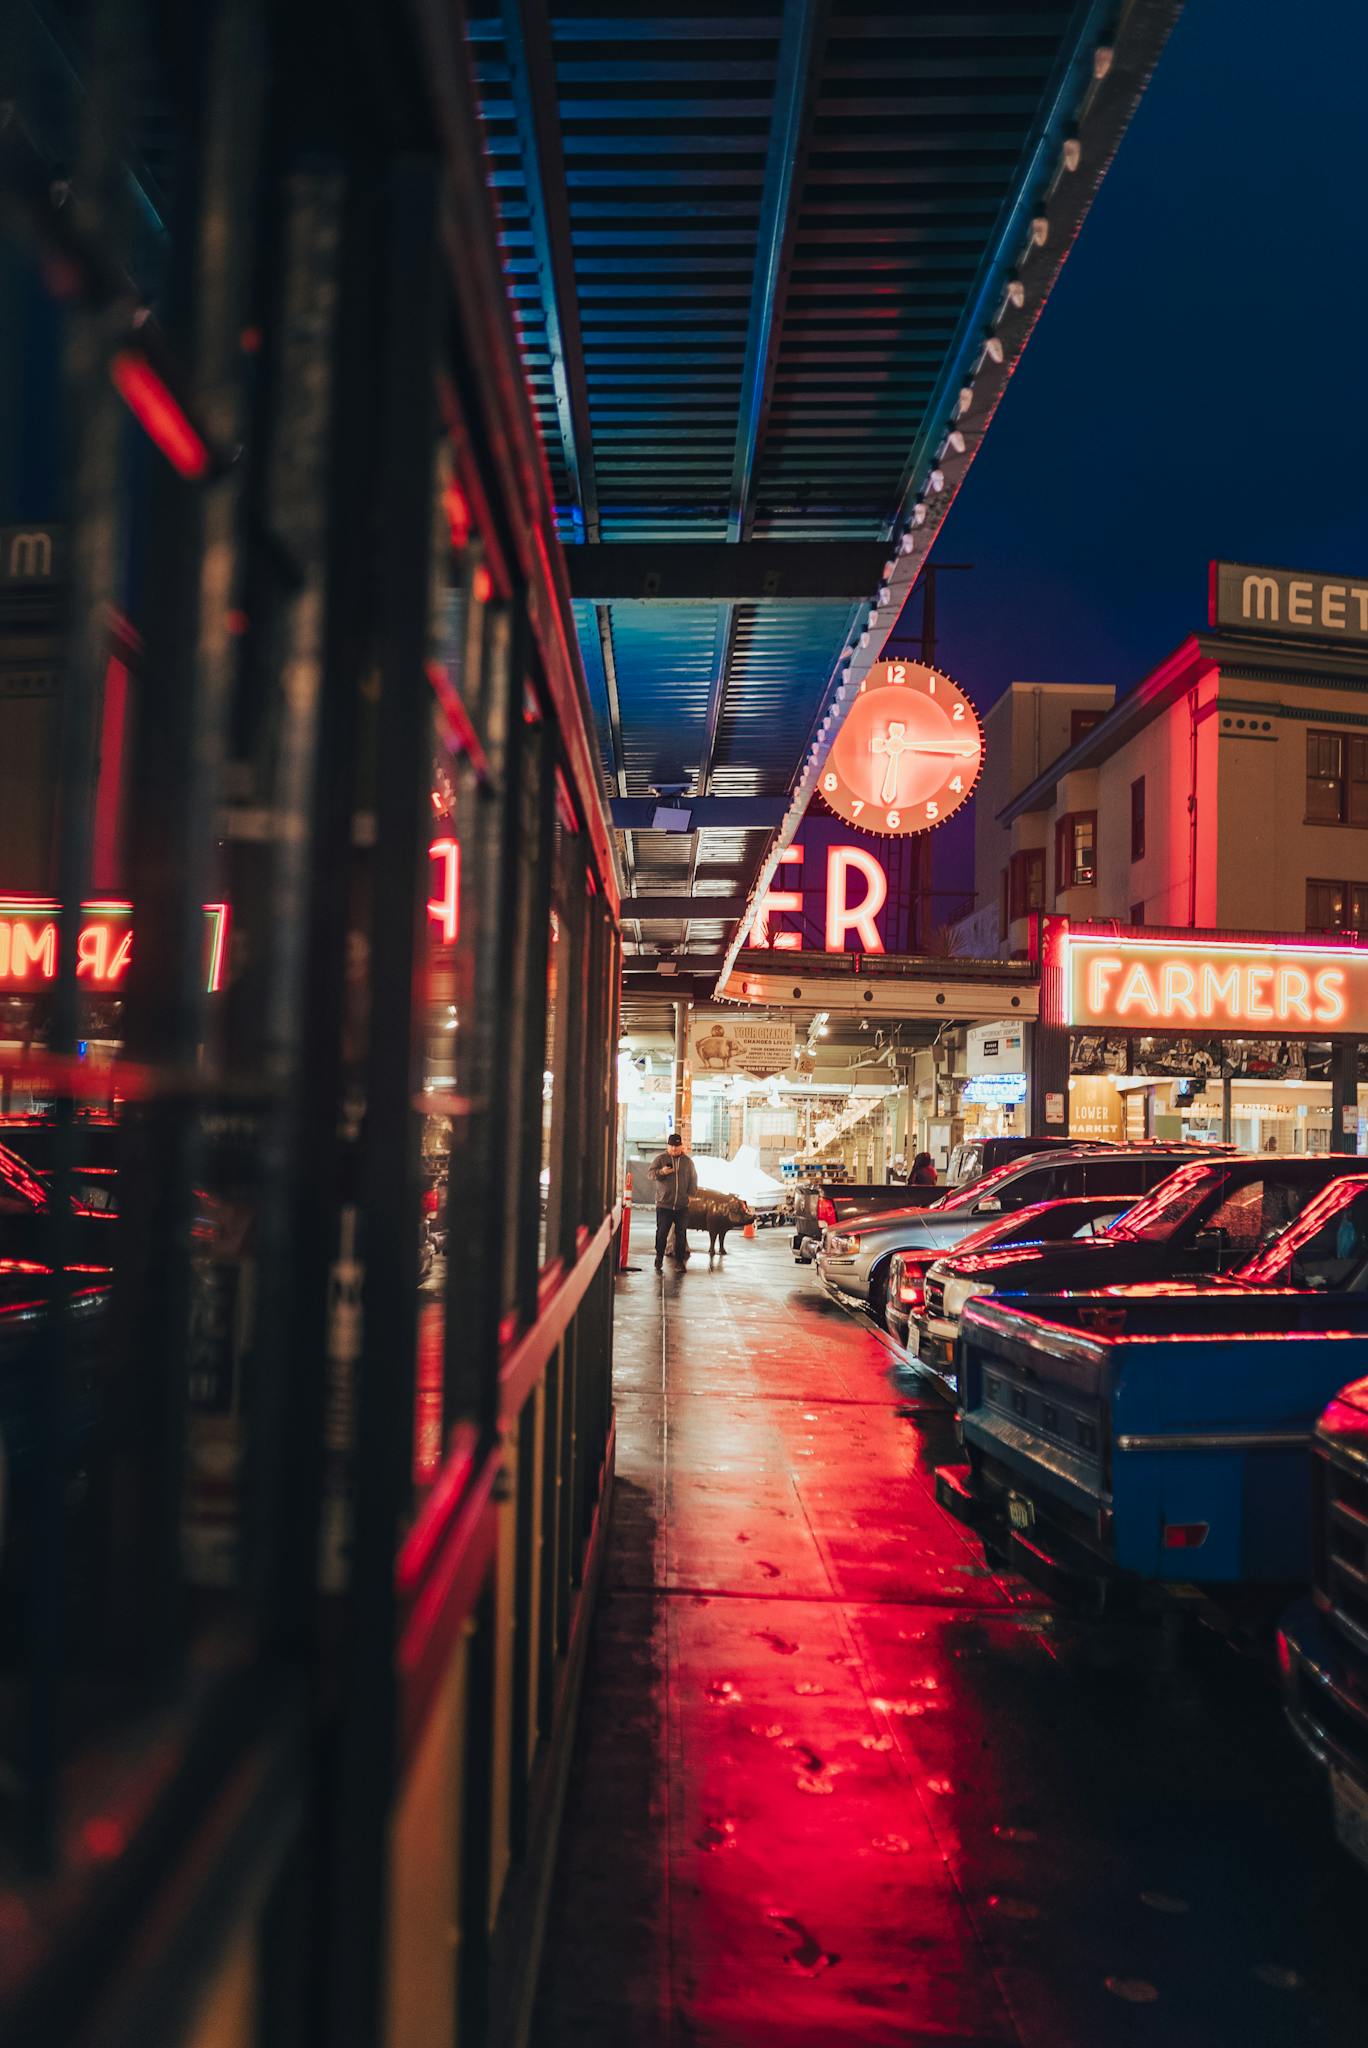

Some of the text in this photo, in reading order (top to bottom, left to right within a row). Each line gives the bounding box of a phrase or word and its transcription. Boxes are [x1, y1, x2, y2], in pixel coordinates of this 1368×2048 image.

[1242, 575, 1368, 631] MEET
[887, 665, 907, 684] 12
[929, 676, 937, 694] 1
[953, 703, 965, 721] 2
[823, 773, 838, 792] 8
[949, 775, 964, 793] 4
[851, 800, 865, 817] 7
[926, 801, 939, 819] 5
[886, 810, 901, 829] 6
[1090, 958, 1346, 1020] FARMERS
[1075, 1105, 1109, 1120] LOWER
